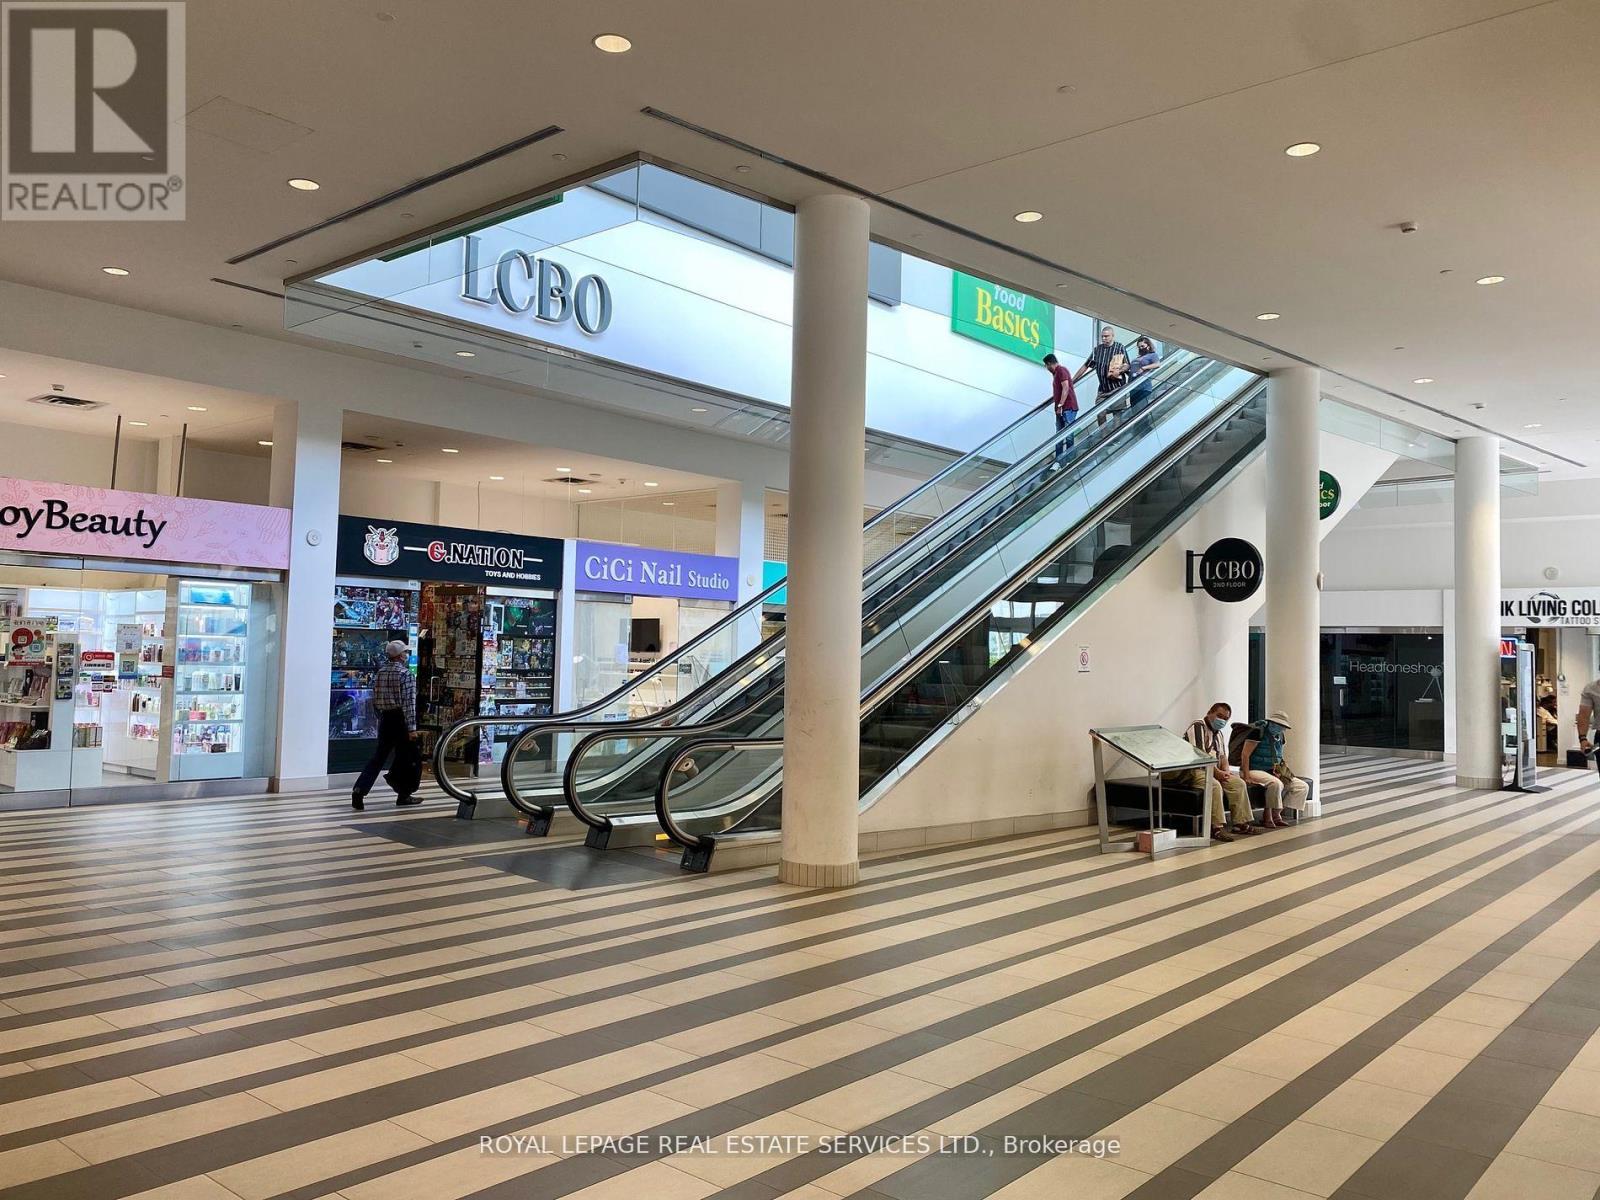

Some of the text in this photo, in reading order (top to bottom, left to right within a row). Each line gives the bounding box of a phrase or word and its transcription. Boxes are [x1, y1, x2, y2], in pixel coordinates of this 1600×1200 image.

[458, 234, 613, 336] LCBO
[427, 541, 525, 570] G.NATION
[484, 570, 542, 581] TOYS AND HOBBIES
[584, 555, 730, 591] CiCi Nail Studio
[1205, 560, 1255, 580] LCBO
[1518, 599, 1567, 617] LIVING
[1571, 599, 1600, 616] COL
[1560, 616, 1592, 625] TATTOO
